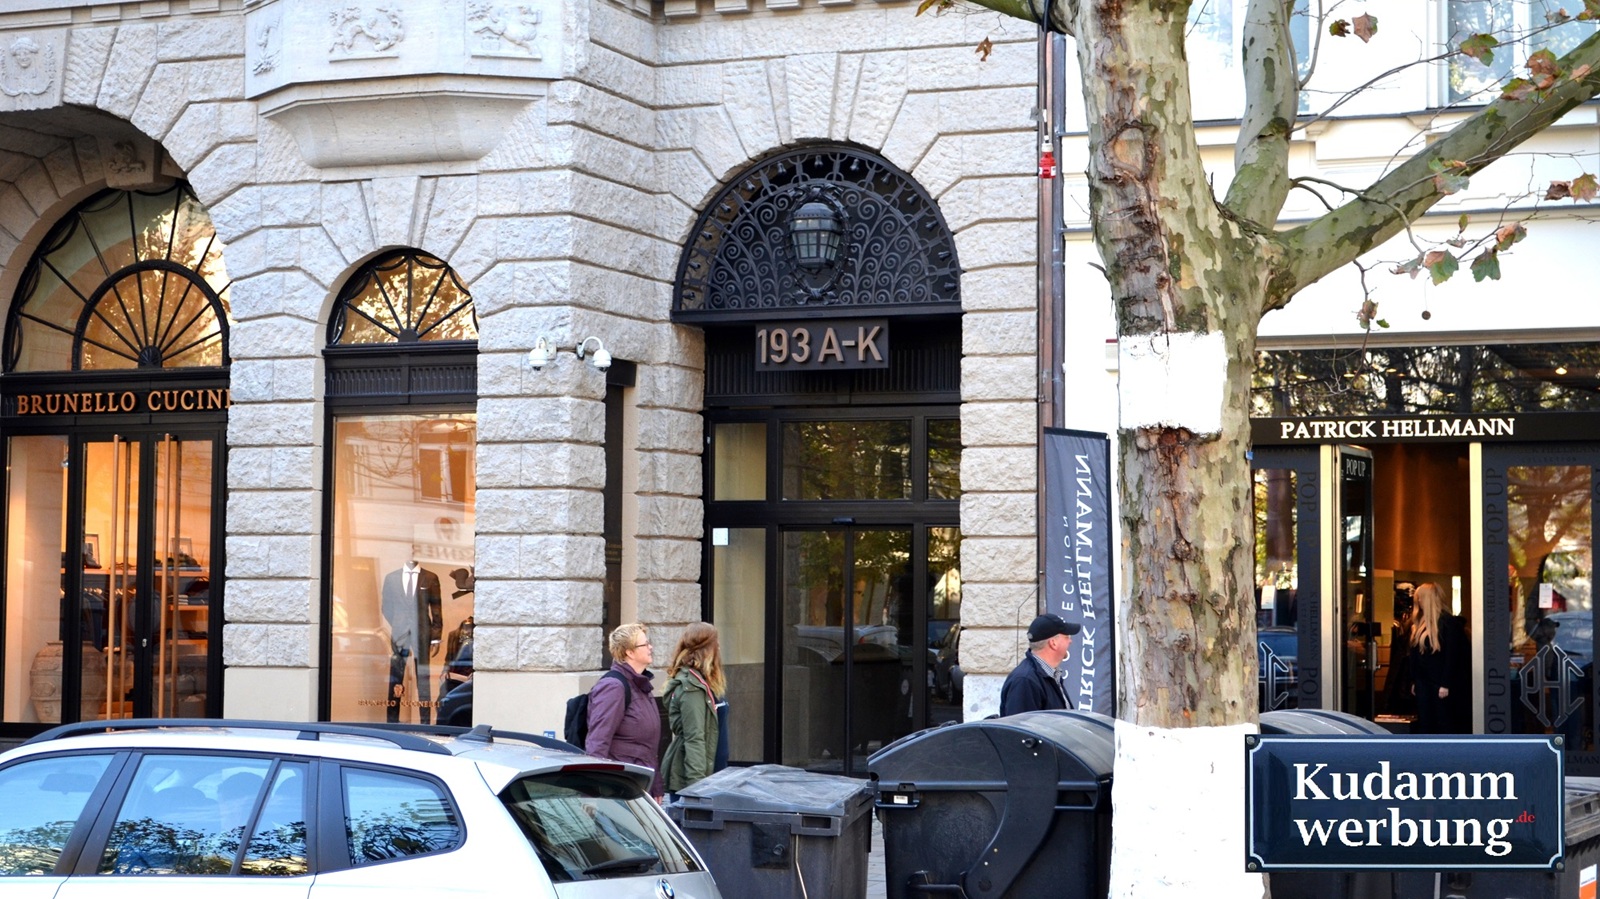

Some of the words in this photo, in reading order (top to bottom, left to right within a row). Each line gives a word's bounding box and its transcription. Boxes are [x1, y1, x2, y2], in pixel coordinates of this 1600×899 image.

[757, 327, 810, 364] 193
[817, 325, 883, 363] A-K
[16, 391, 136, 415] BRUNELLO
[1281, 419, 1377, 440] PATRICK
[1382, 418, 1515, 438] HELLMANN
[1346, 458, 1357, 476] POP
[1301, 472, 1318, 511] POP
[1485, 468, 1504, 497] UP
[1486, 504, 1504, 546] POP
[1488, 667, 1506, 696] UP
